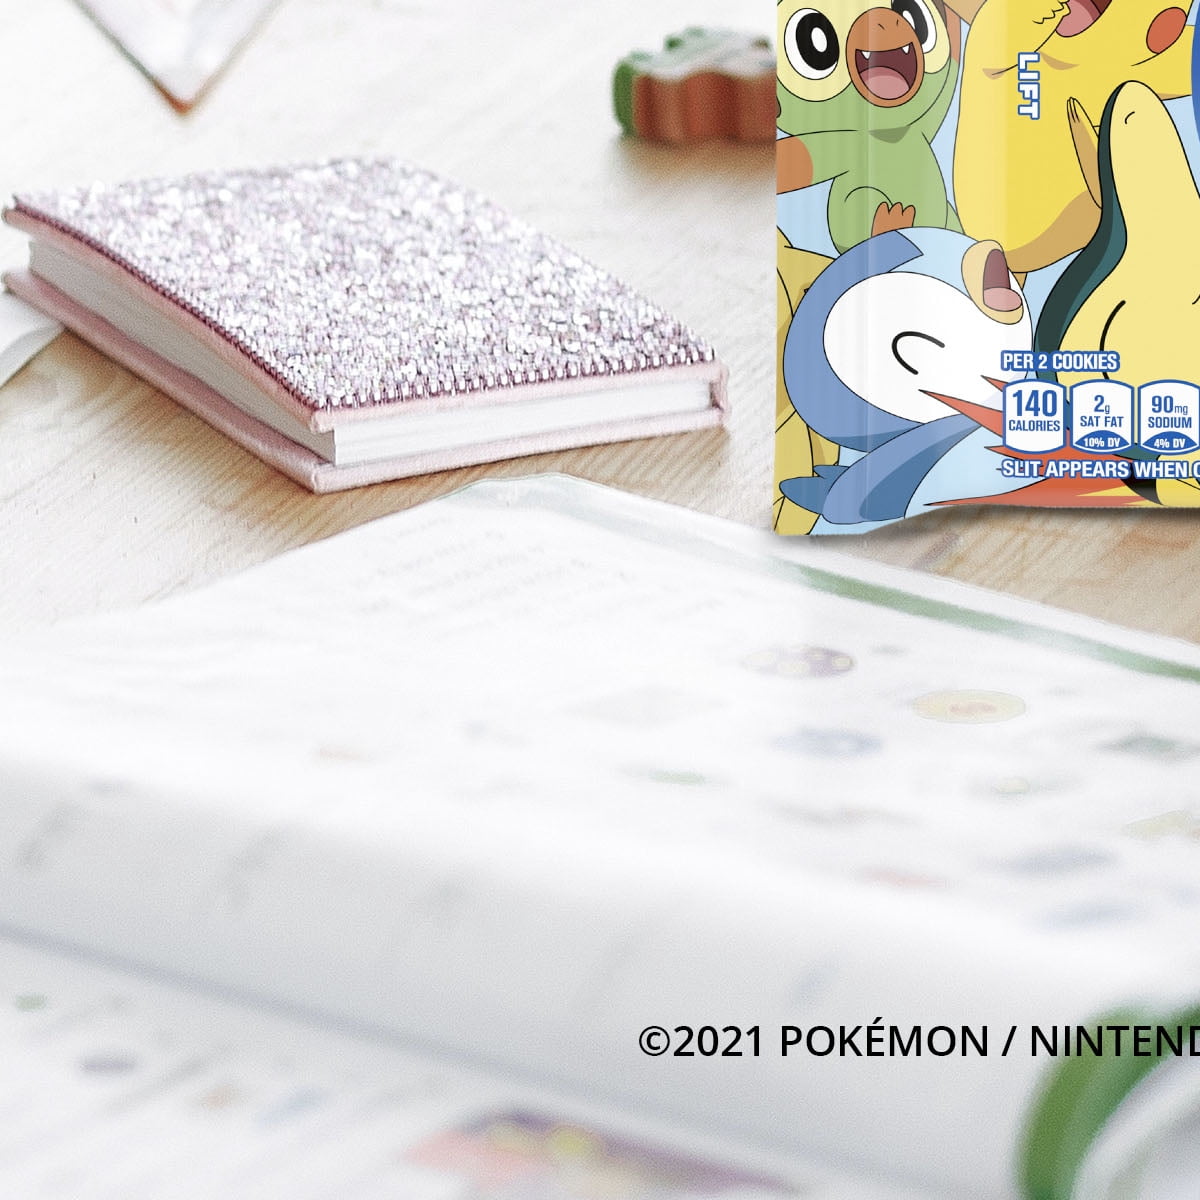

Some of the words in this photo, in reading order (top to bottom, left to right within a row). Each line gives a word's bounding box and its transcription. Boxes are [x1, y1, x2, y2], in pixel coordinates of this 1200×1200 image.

[1018, 52, 1040, 120] LIFT
[1002, 352, 1034, 370] PER
[1038, 352, 1048, 370] 2
[1052, 352, 1119, 370] COOKIES
[1012, 389, 1058, 418] 140
[1008, 419, 1061, 432] CALORIES
[1079, 415, 1101, 428] SAT
[1104, 415, 1125, 428] FAT
[1147, 416, 1193, 429] SODIUM
[1083, 436, 1105, 448] 10%
[1107, 436, 1121, 448] DV
[1153, 437, 1170, 449] 4%
[1172, 437, 1186, 449] DV
[1002, 460, 1042, 478] SLIT
[1046, 460, 1130, 478] APPEARS
[1133, 461, 1192, 479] WHEN
